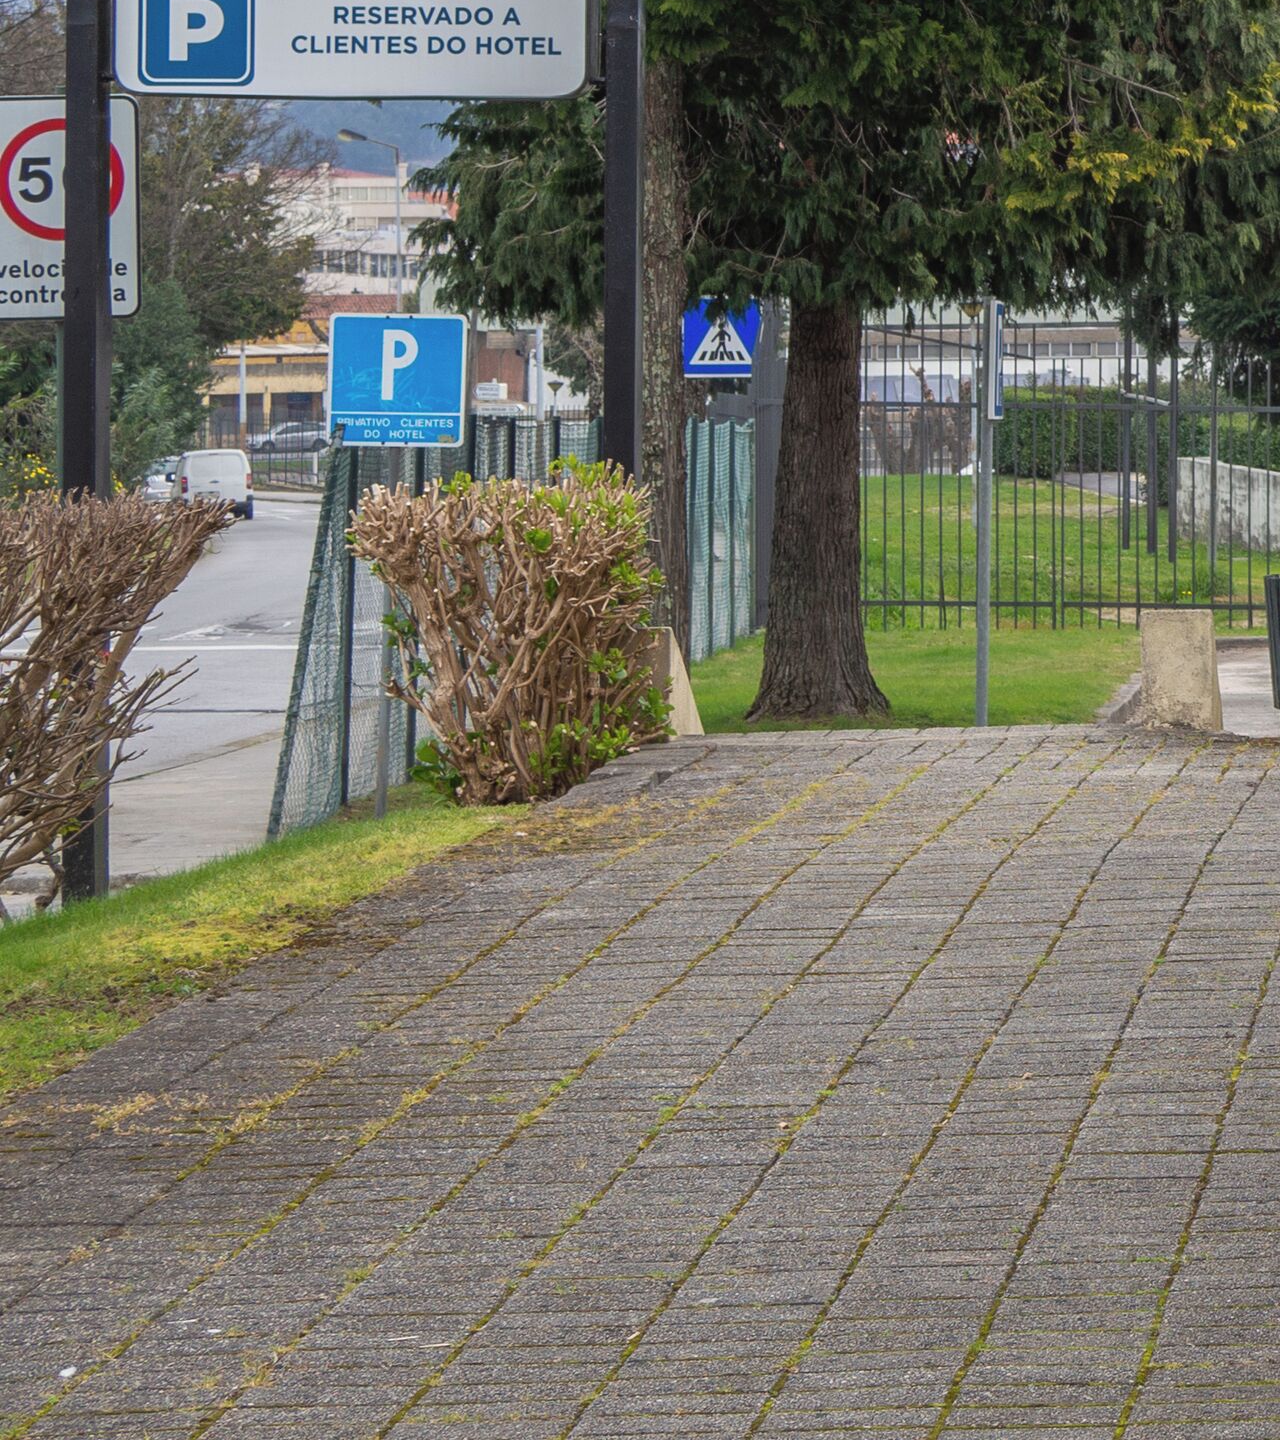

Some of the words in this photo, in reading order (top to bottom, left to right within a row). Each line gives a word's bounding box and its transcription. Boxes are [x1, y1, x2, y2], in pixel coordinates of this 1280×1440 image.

[332, 5, 494, 27] RESERVADO
[501, 6, 521, 26] A
[291, 34, 418, 55] CLIENTES
[427, 35, 467, 55] DO
[475, 36, 563, 56] HOTEL
[381, 329, 419, 401] P
[336, 417, 391, 427] PRIVATIVO
[400, 418, 455, 428] CLIENTES
[364, 429, 381, 439] DO
[389, 429, 425, 440] HOTEL
